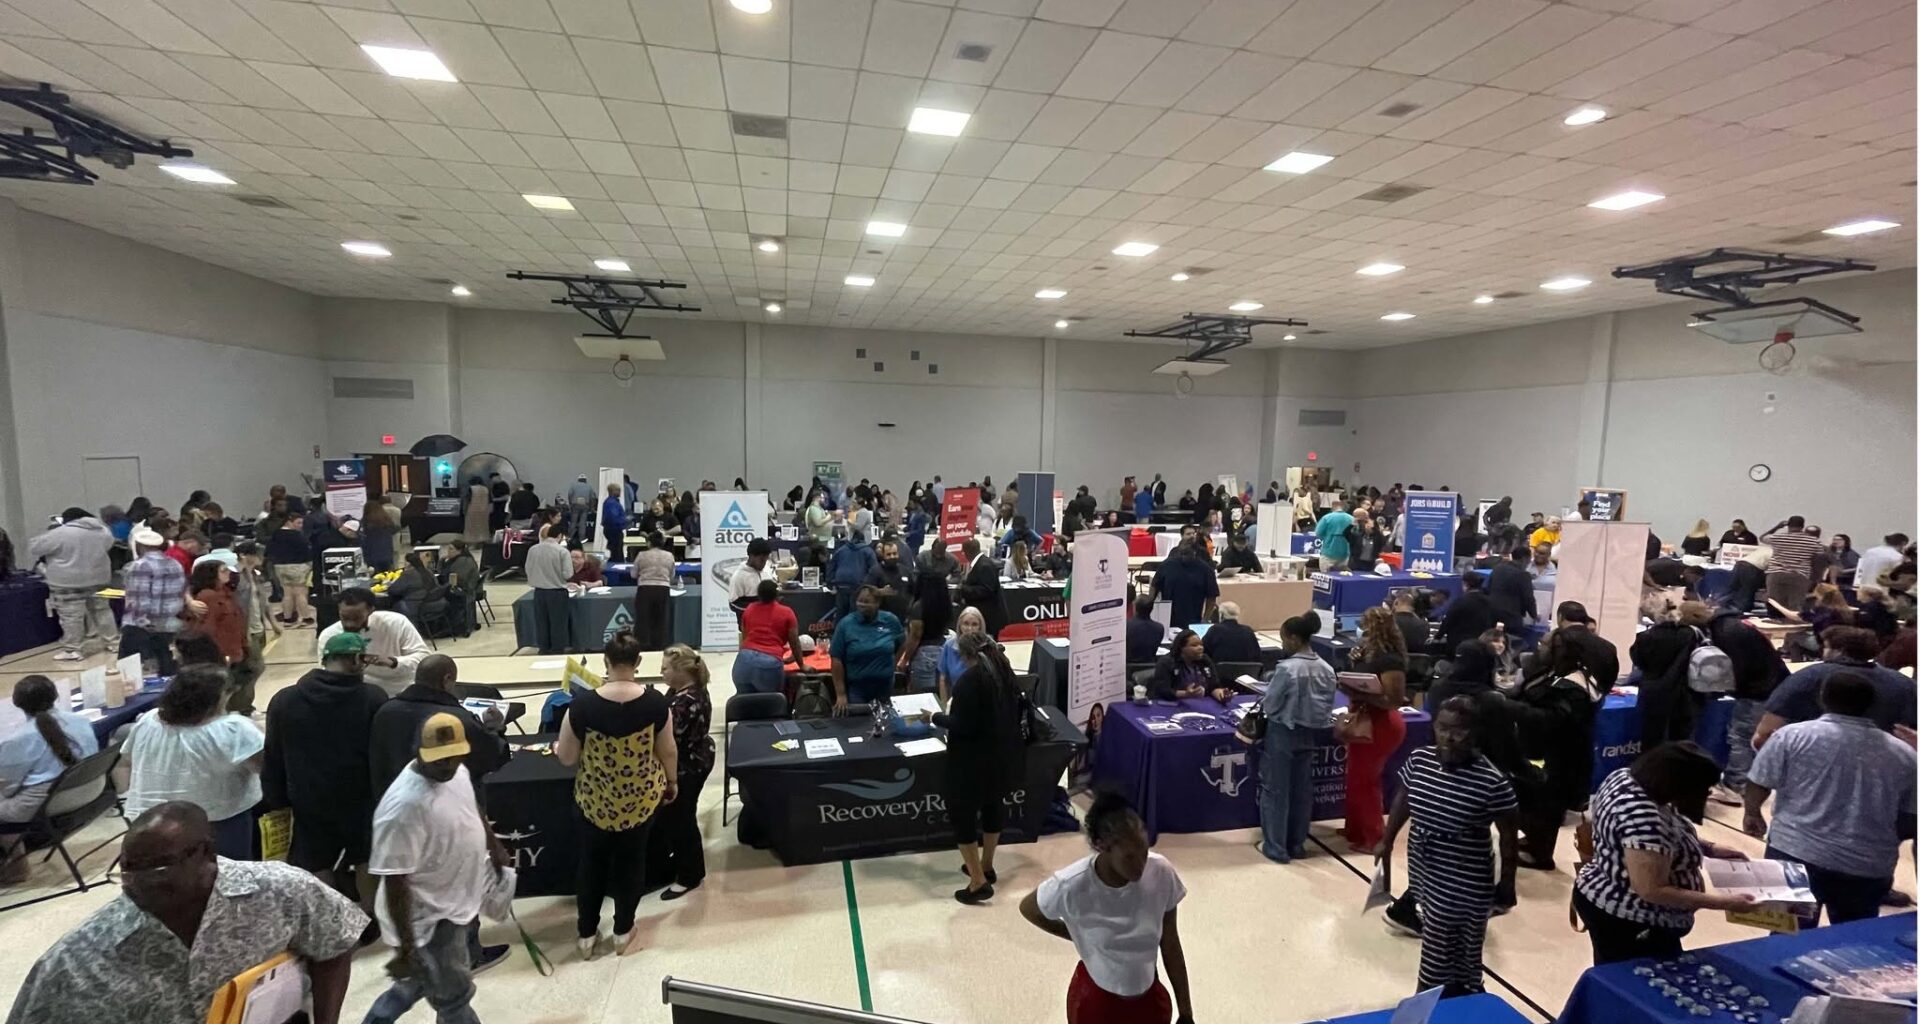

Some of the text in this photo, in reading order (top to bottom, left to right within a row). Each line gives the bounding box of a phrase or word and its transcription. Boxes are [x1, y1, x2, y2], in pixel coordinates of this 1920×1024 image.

[948, 504, 961, 512] Earn
[1593, 500, 1610, 508] Find
[955, 522, 968, 530] your
[715, 531, 755, 544] atco
